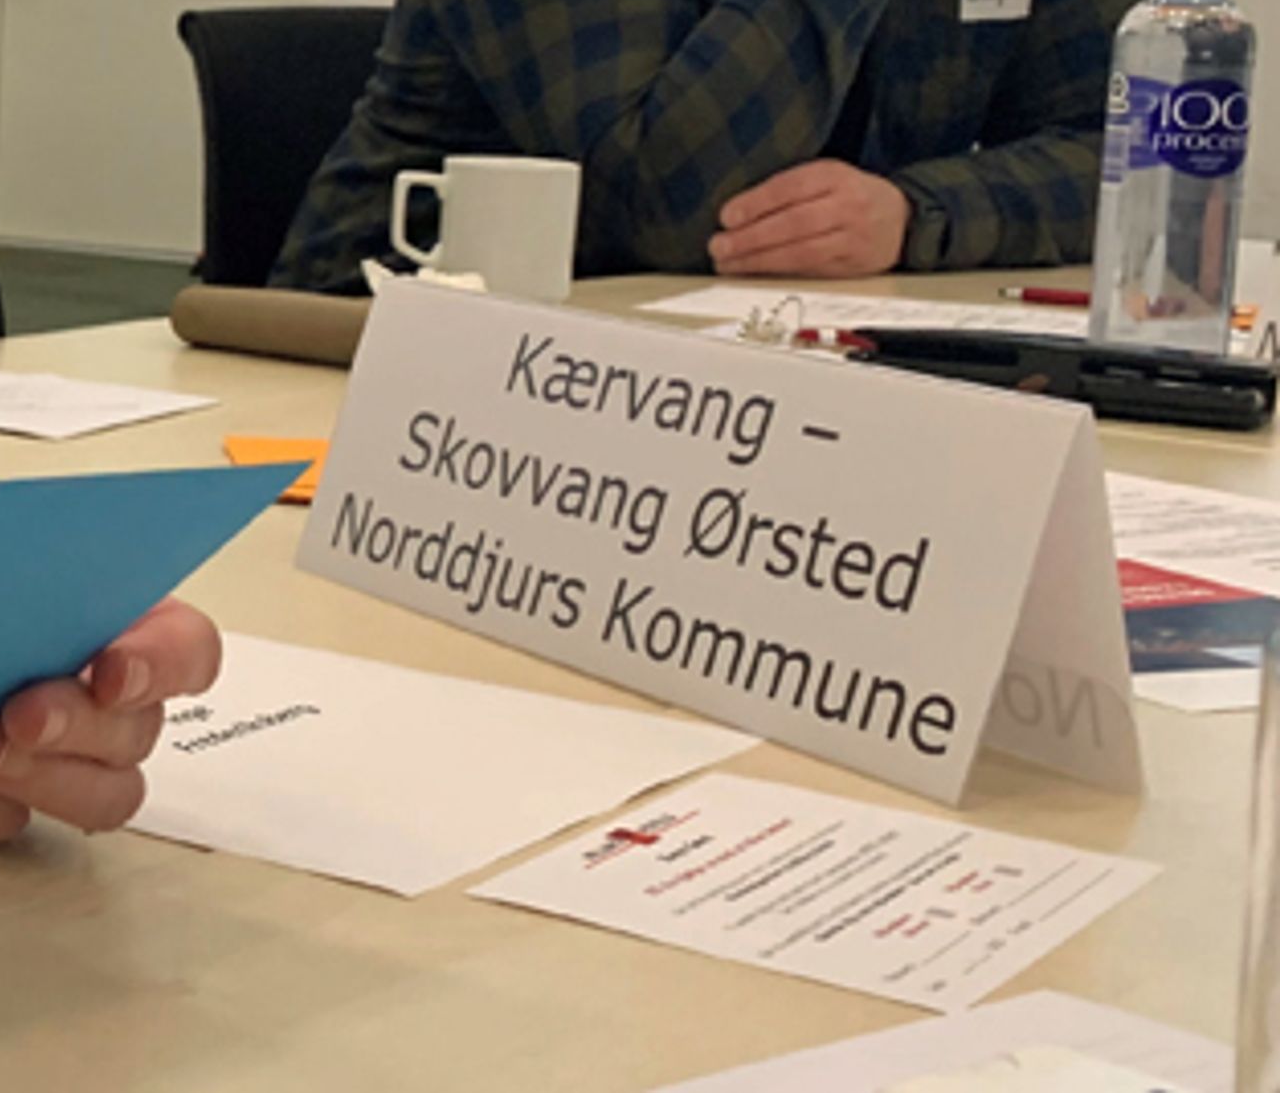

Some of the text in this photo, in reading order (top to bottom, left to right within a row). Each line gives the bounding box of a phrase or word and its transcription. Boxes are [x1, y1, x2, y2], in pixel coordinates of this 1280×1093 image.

[504, 331, 776, 465] Kærvang
[397, 411, 931, 614] Skovvang Ørsted
[330, 491, 958, 757] Norddjurs Kommune
